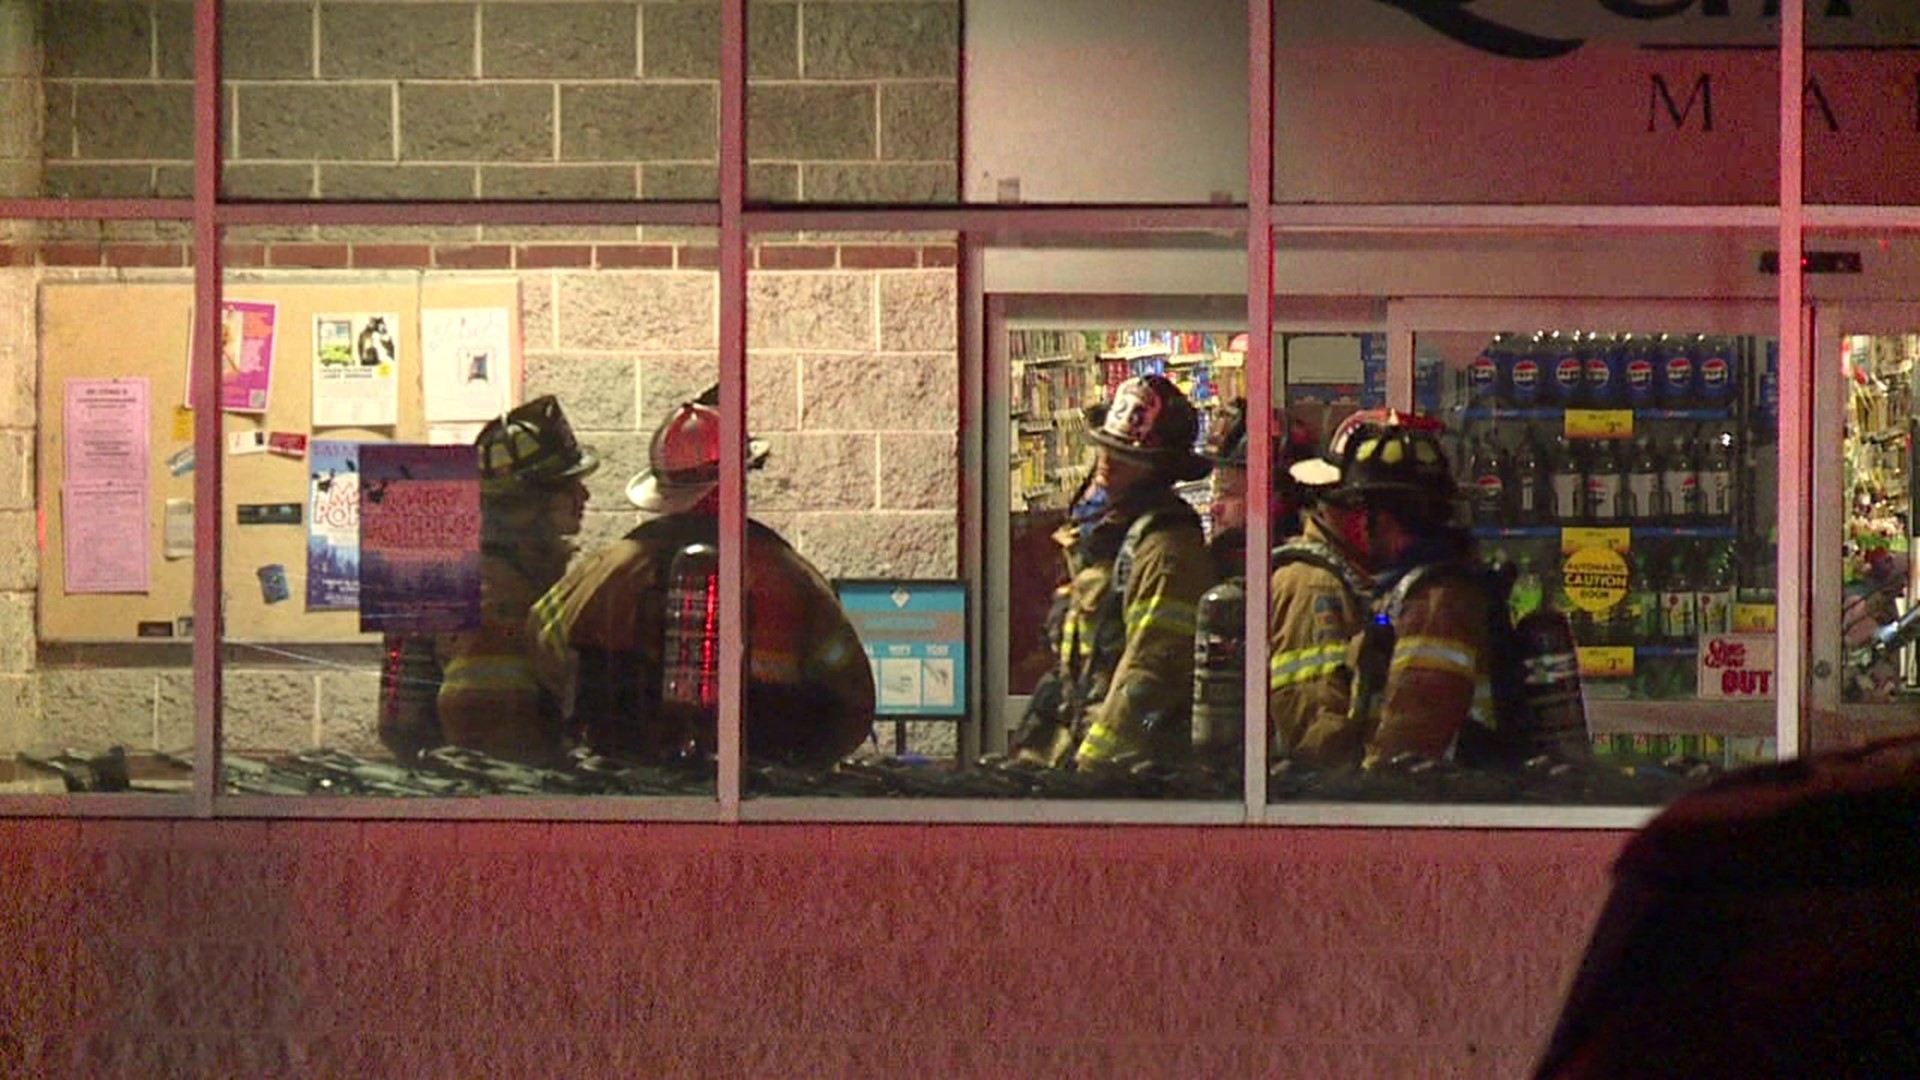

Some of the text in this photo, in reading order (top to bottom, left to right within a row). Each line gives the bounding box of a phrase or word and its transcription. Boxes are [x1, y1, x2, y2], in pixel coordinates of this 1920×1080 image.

[1648, 73, 1920, 131] MA
[1564, 573, 1628, 587] CAUTION
[1579, 589, 1610, 599] DOOR
[1722, 669, 1772, 695] OUT
